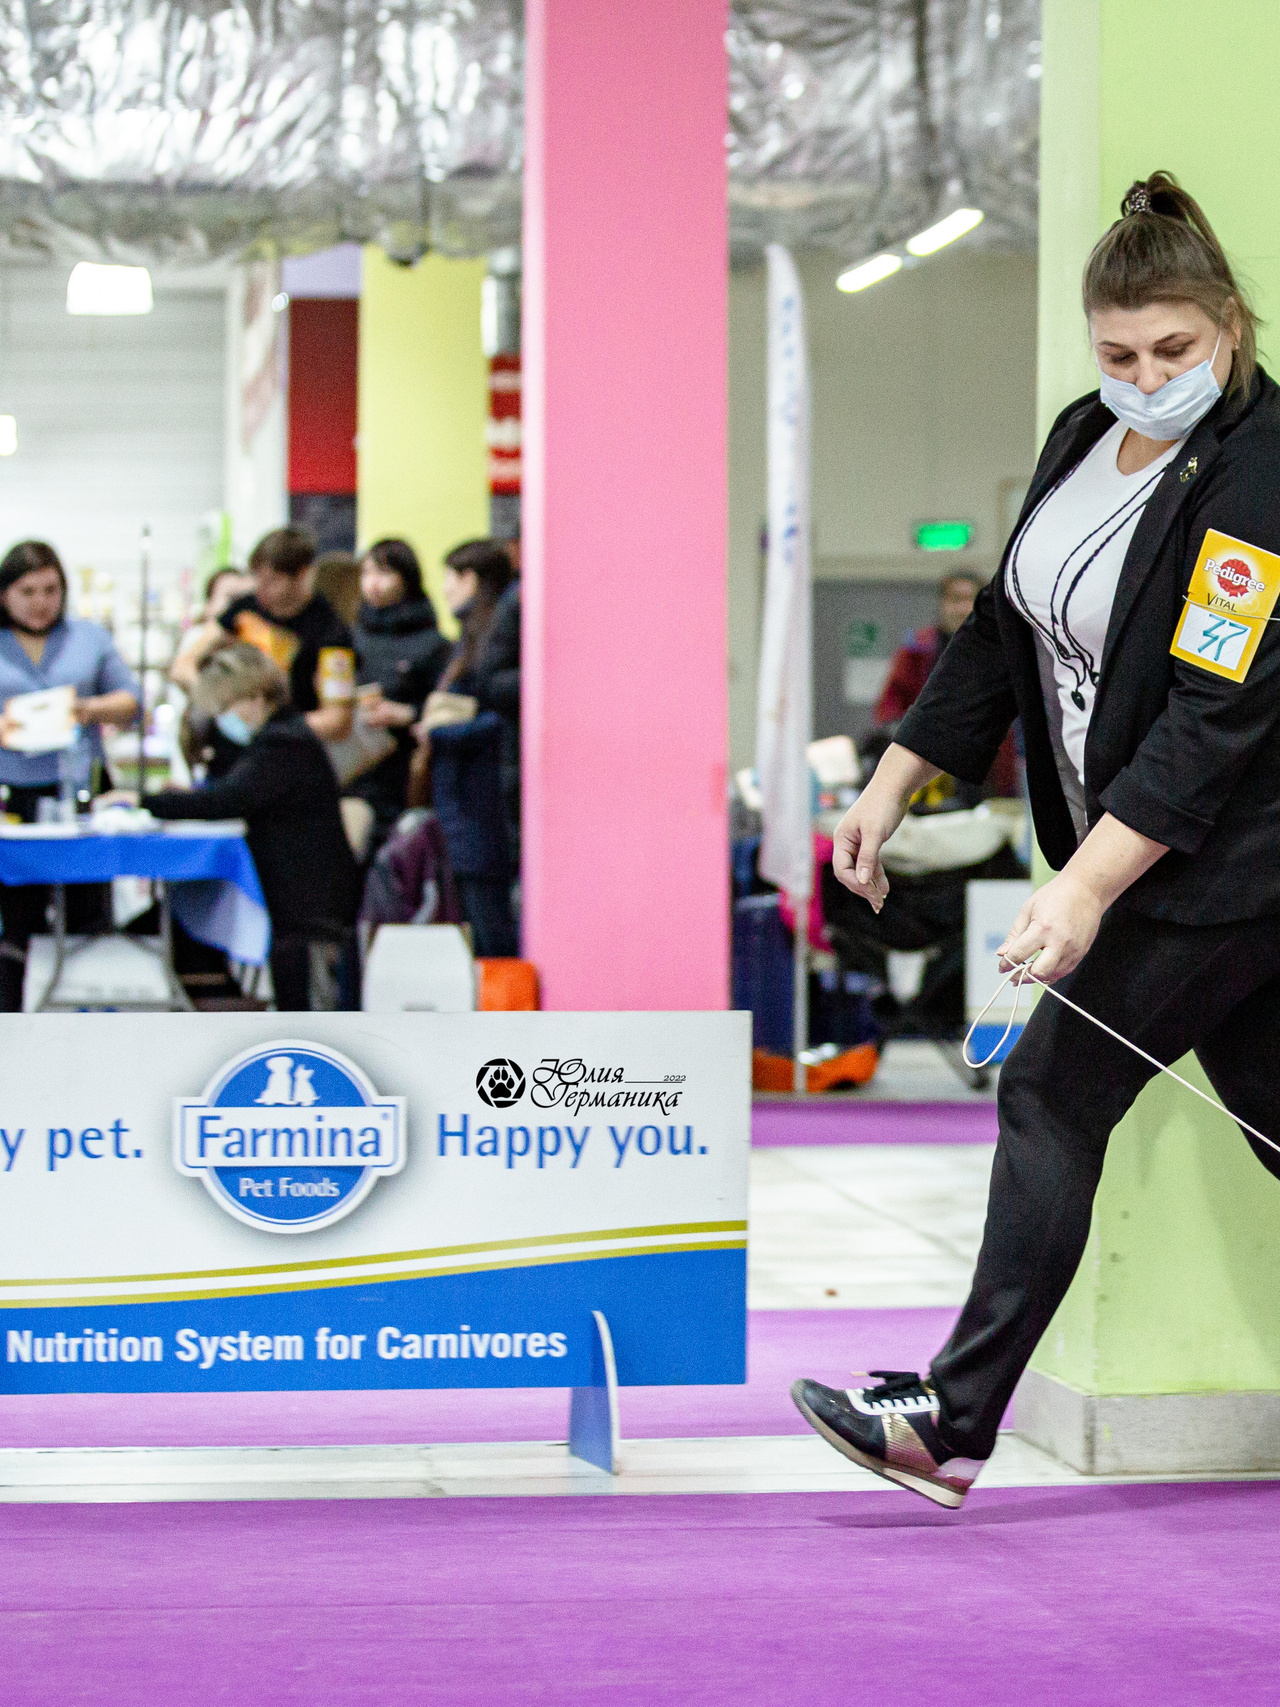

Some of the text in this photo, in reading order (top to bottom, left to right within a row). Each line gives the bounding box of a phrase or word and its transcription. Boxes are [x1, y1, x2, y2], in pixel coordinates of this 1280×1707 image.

[1203, 557, 1266, 593] Pedigree
[46, 1118, 145, 1172] pet.
[197, 1114, 383, 1159] Farmina
[437, 1112, 710, 1169] Happy you.
[239, 1177, 342, 1198] Pet Foods
[6, 1325, 569, 1369] Nutrition System for Carnivores
